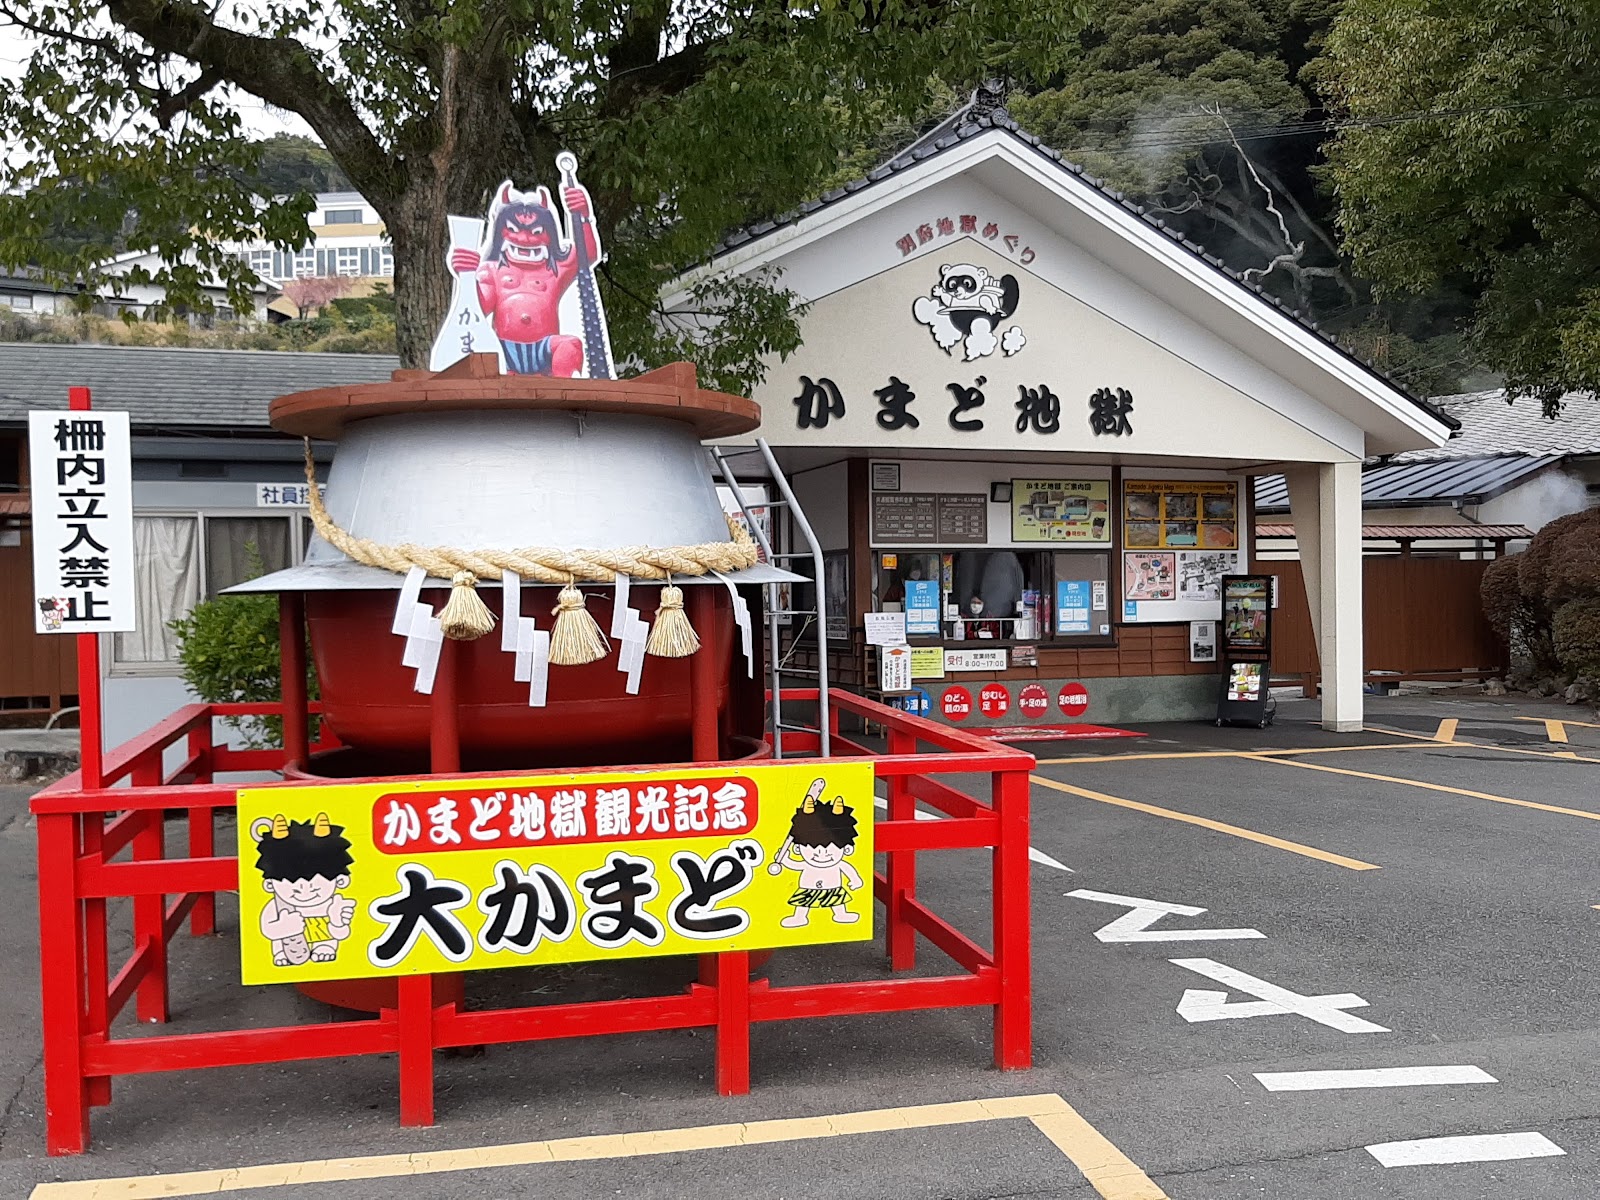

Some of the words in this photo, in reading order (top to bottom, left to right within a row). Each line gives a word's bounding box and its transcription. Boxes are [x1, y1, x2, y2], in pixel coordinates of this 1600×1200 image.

[895, 214, 1036, 266] 別府地獄めぐり
[458, 307, 480, 353] かま
[793, 375, 1135, 437] かまど地獄
[54, 418, 111, 622] 柵内立入禁止
[947, 655, 963, 666] 受付
[382, 780, 749, 848] かまど地獄観光記念
[371, 838, 762, 966] 大かまど
